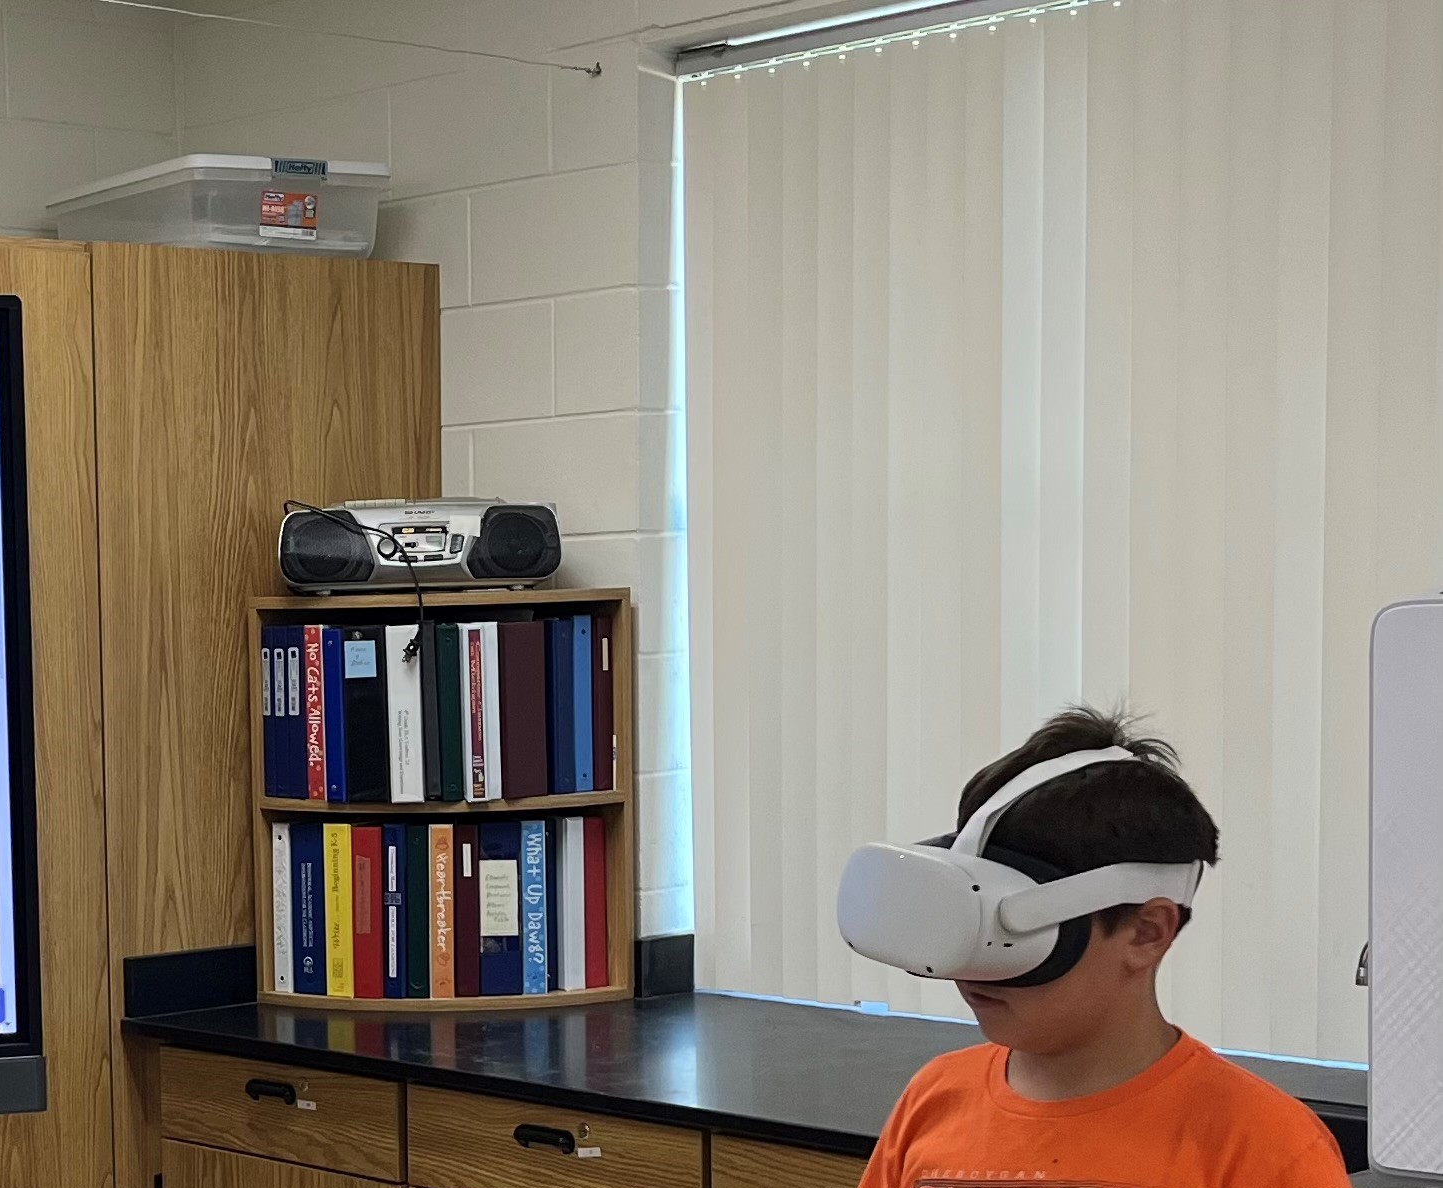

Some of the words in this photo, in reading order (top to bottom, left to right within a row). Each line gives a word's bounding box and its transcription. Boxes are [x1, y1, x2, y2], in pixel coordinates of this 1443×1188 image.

[306, 643, 319, 661] No
[307, 666, 319, 702] Cats
[309, 707, 322, 767] Allowed.
[332, 849, 340, 892] Beginning
[526, 833, 543, 877] What
[435, 852, 452, 953] Heartbreaker
[525, 884, 543, 905] Up
[528, 912, 544, 964] Dawg?
